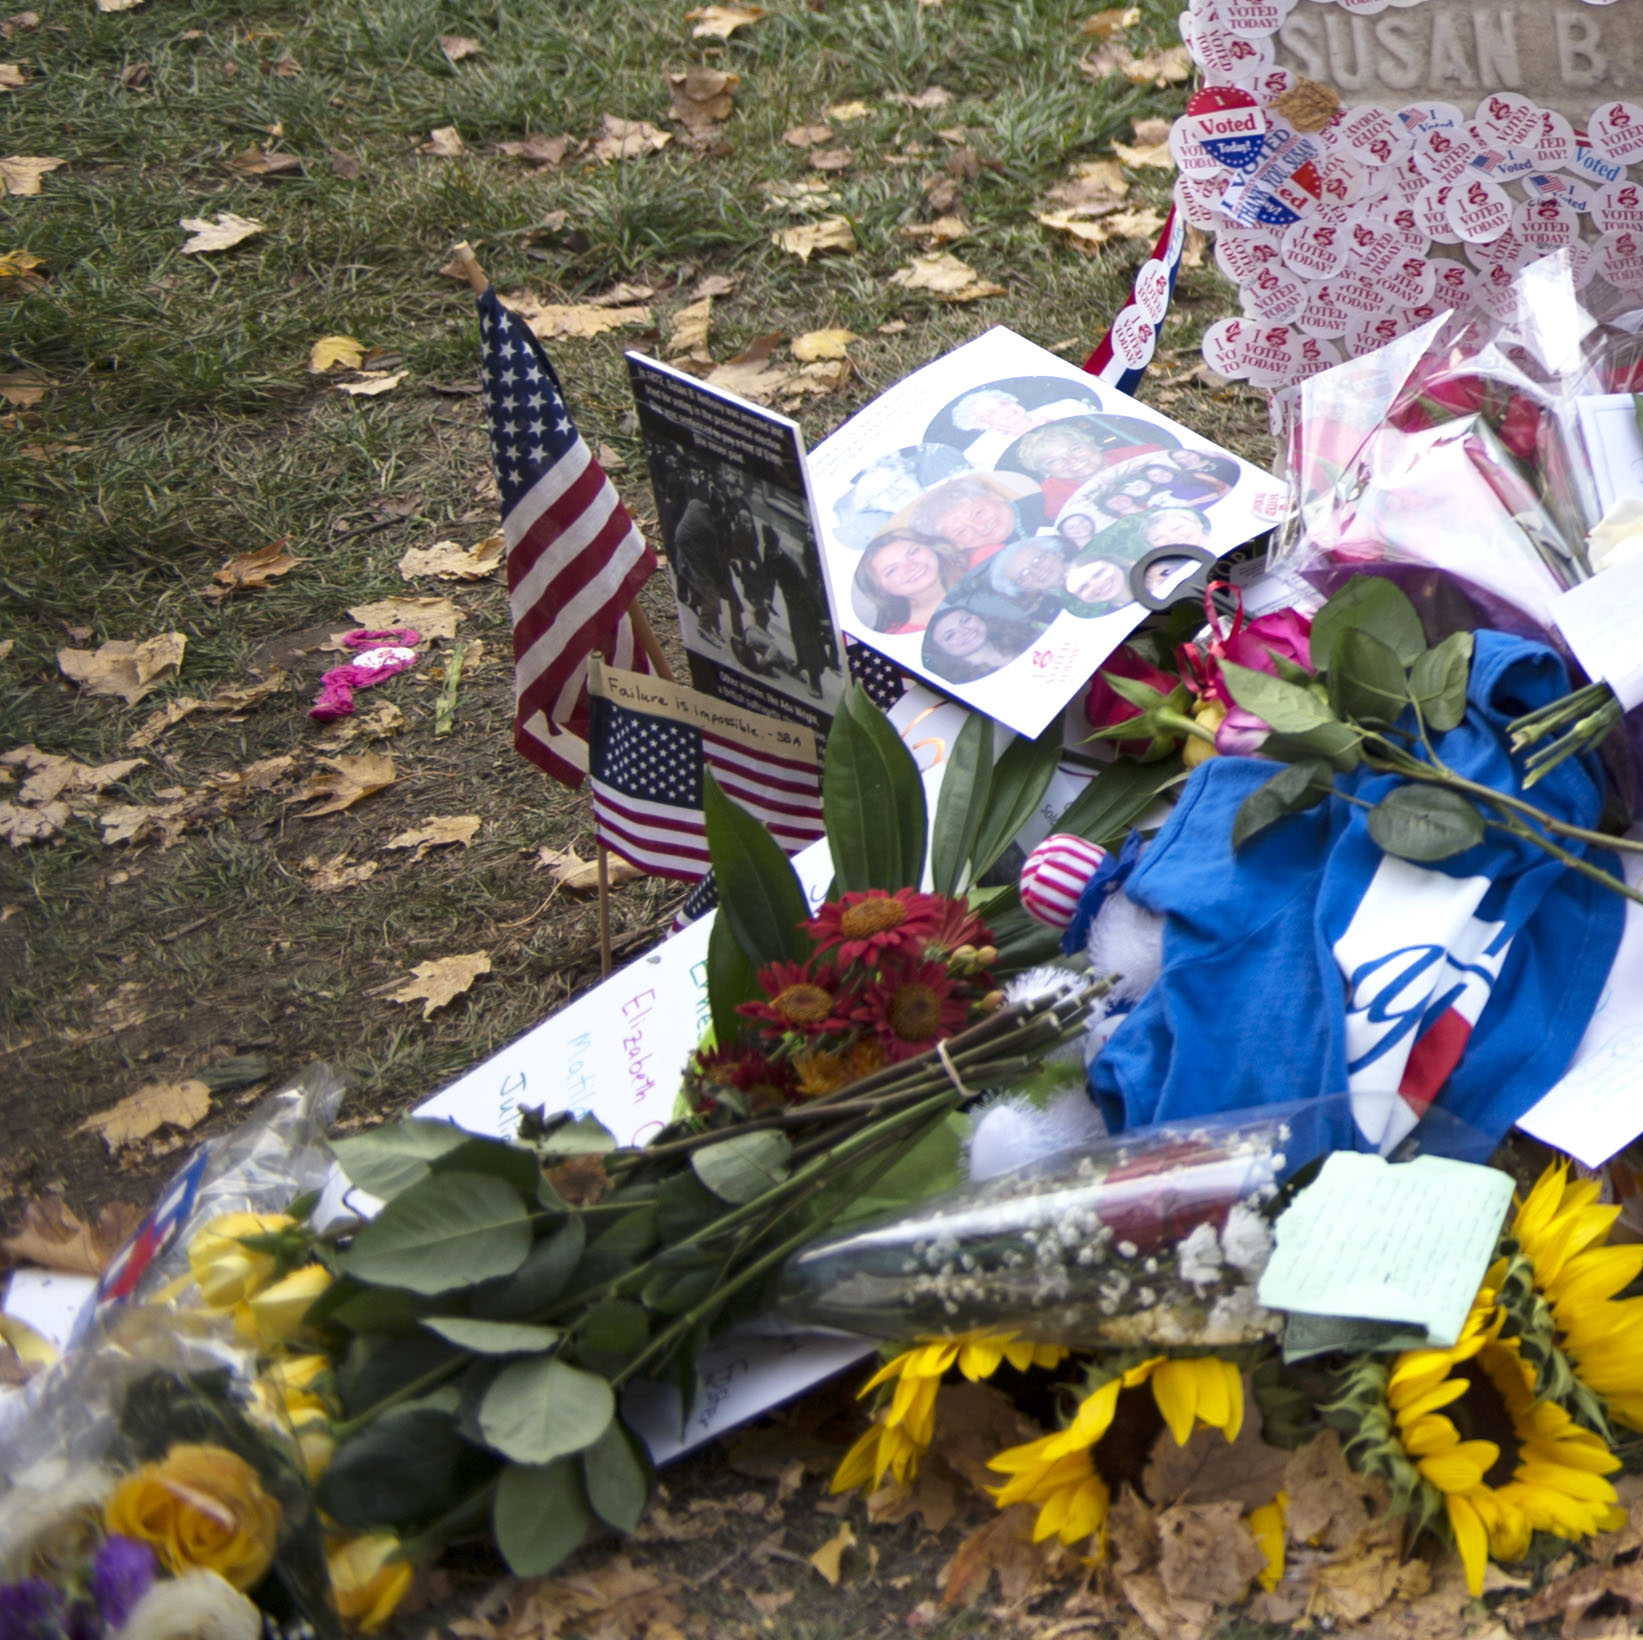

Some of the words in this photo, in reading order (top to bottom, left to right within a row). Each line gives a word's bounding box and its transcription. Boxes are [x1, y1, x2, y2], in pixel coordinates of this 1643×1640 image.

[1276, 9, 1521, 89] SUSAN
[1214, 94, 1226, 107] I
[1197, 112, 1258, 136] Voted
[1216, 140, 1253, 154] Today!
[1573, 144, 1622, 183] Voted
[1456, 198, 1469, 215] I
[1459, 202, 1505, 225] VOTED
[1464, 212, 1510, 238] TODAY!
[607, 676, 669, 707] Failure
[676, 696, 690, 713] is
[621, 988, 657, 1105] Elizabeth
